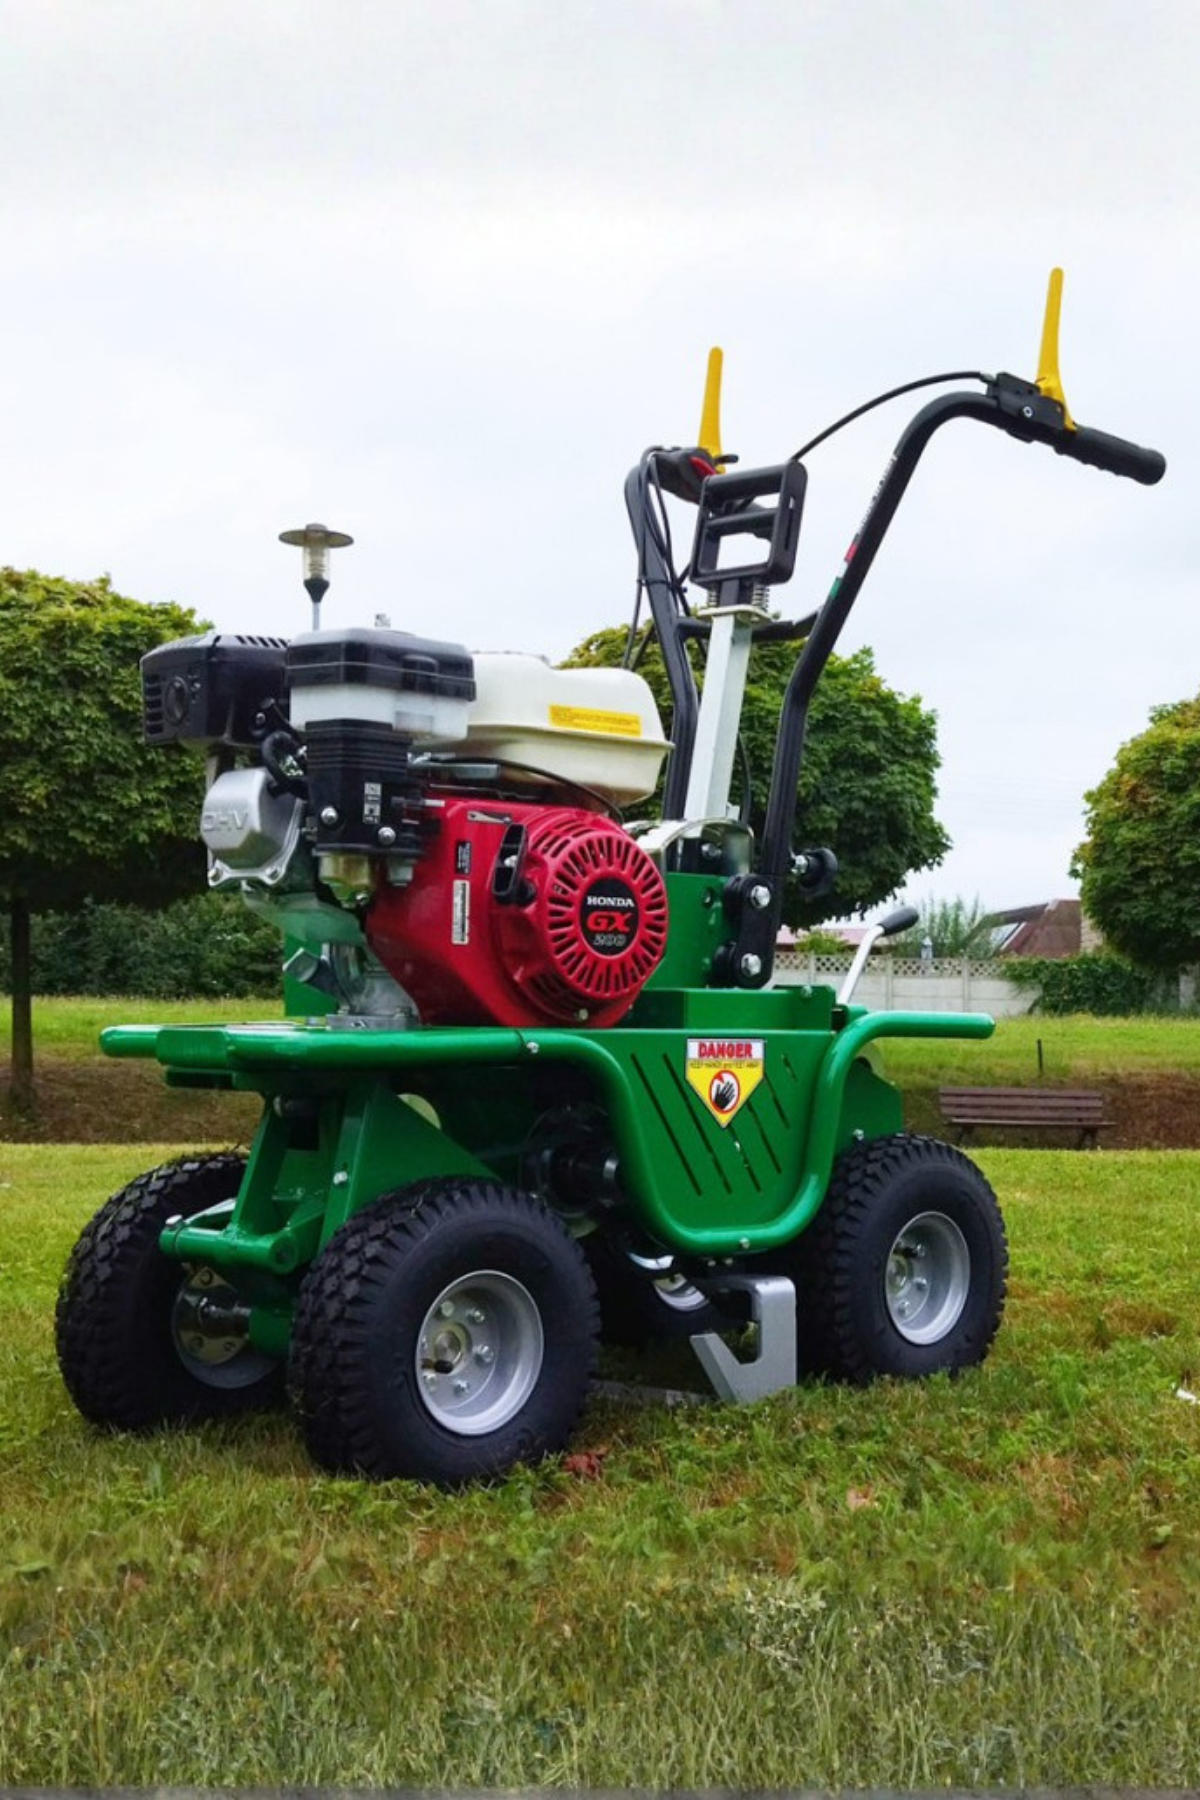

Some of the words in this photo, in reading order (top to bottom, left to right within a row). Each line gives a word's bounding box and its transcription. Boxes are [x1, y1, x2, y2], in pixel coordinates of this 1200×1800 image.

[586, 895, 635, 907] HONDA
[587, 911, 634, 932] GX
[698, 1041, 752, 1058] DANGER
